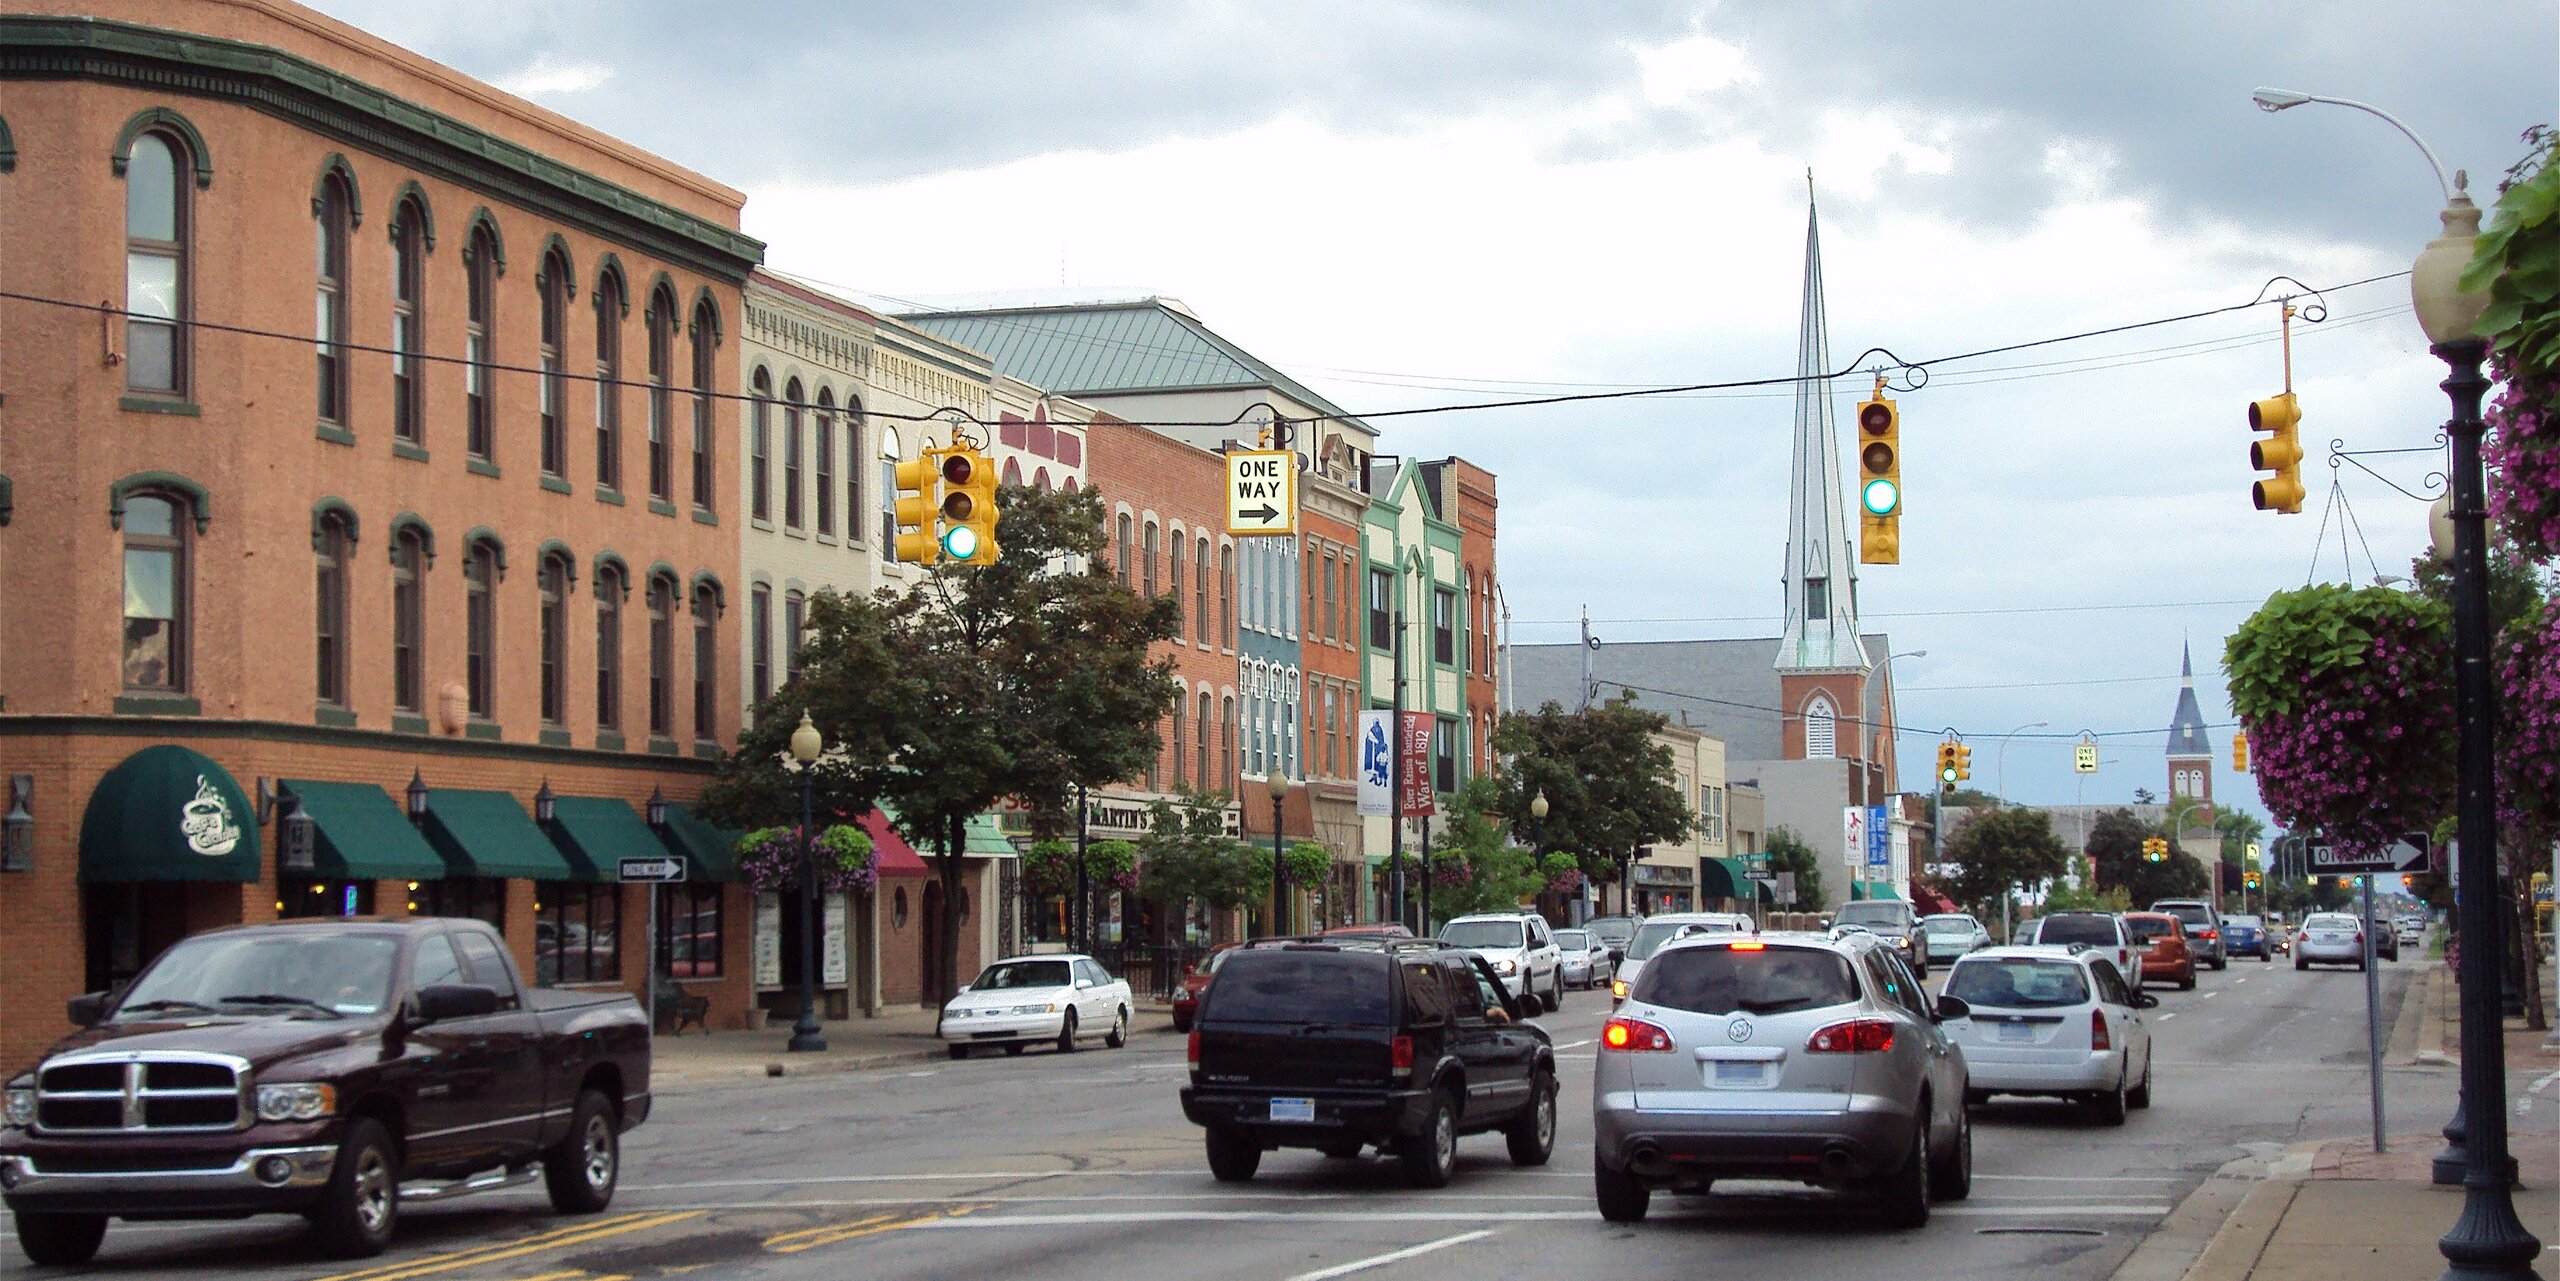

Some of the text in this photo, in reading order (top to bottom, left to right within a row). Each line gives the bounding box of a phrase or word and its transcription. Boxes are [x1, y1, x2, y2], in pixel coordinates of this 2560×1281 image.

[1240, 461, 1278, 477] ONE
[1238, 482, 1280, 498] WAY
[1415, 730, 1431, 809] War of 1812
[1090, 802, 1147, 830] MARTIN'S
